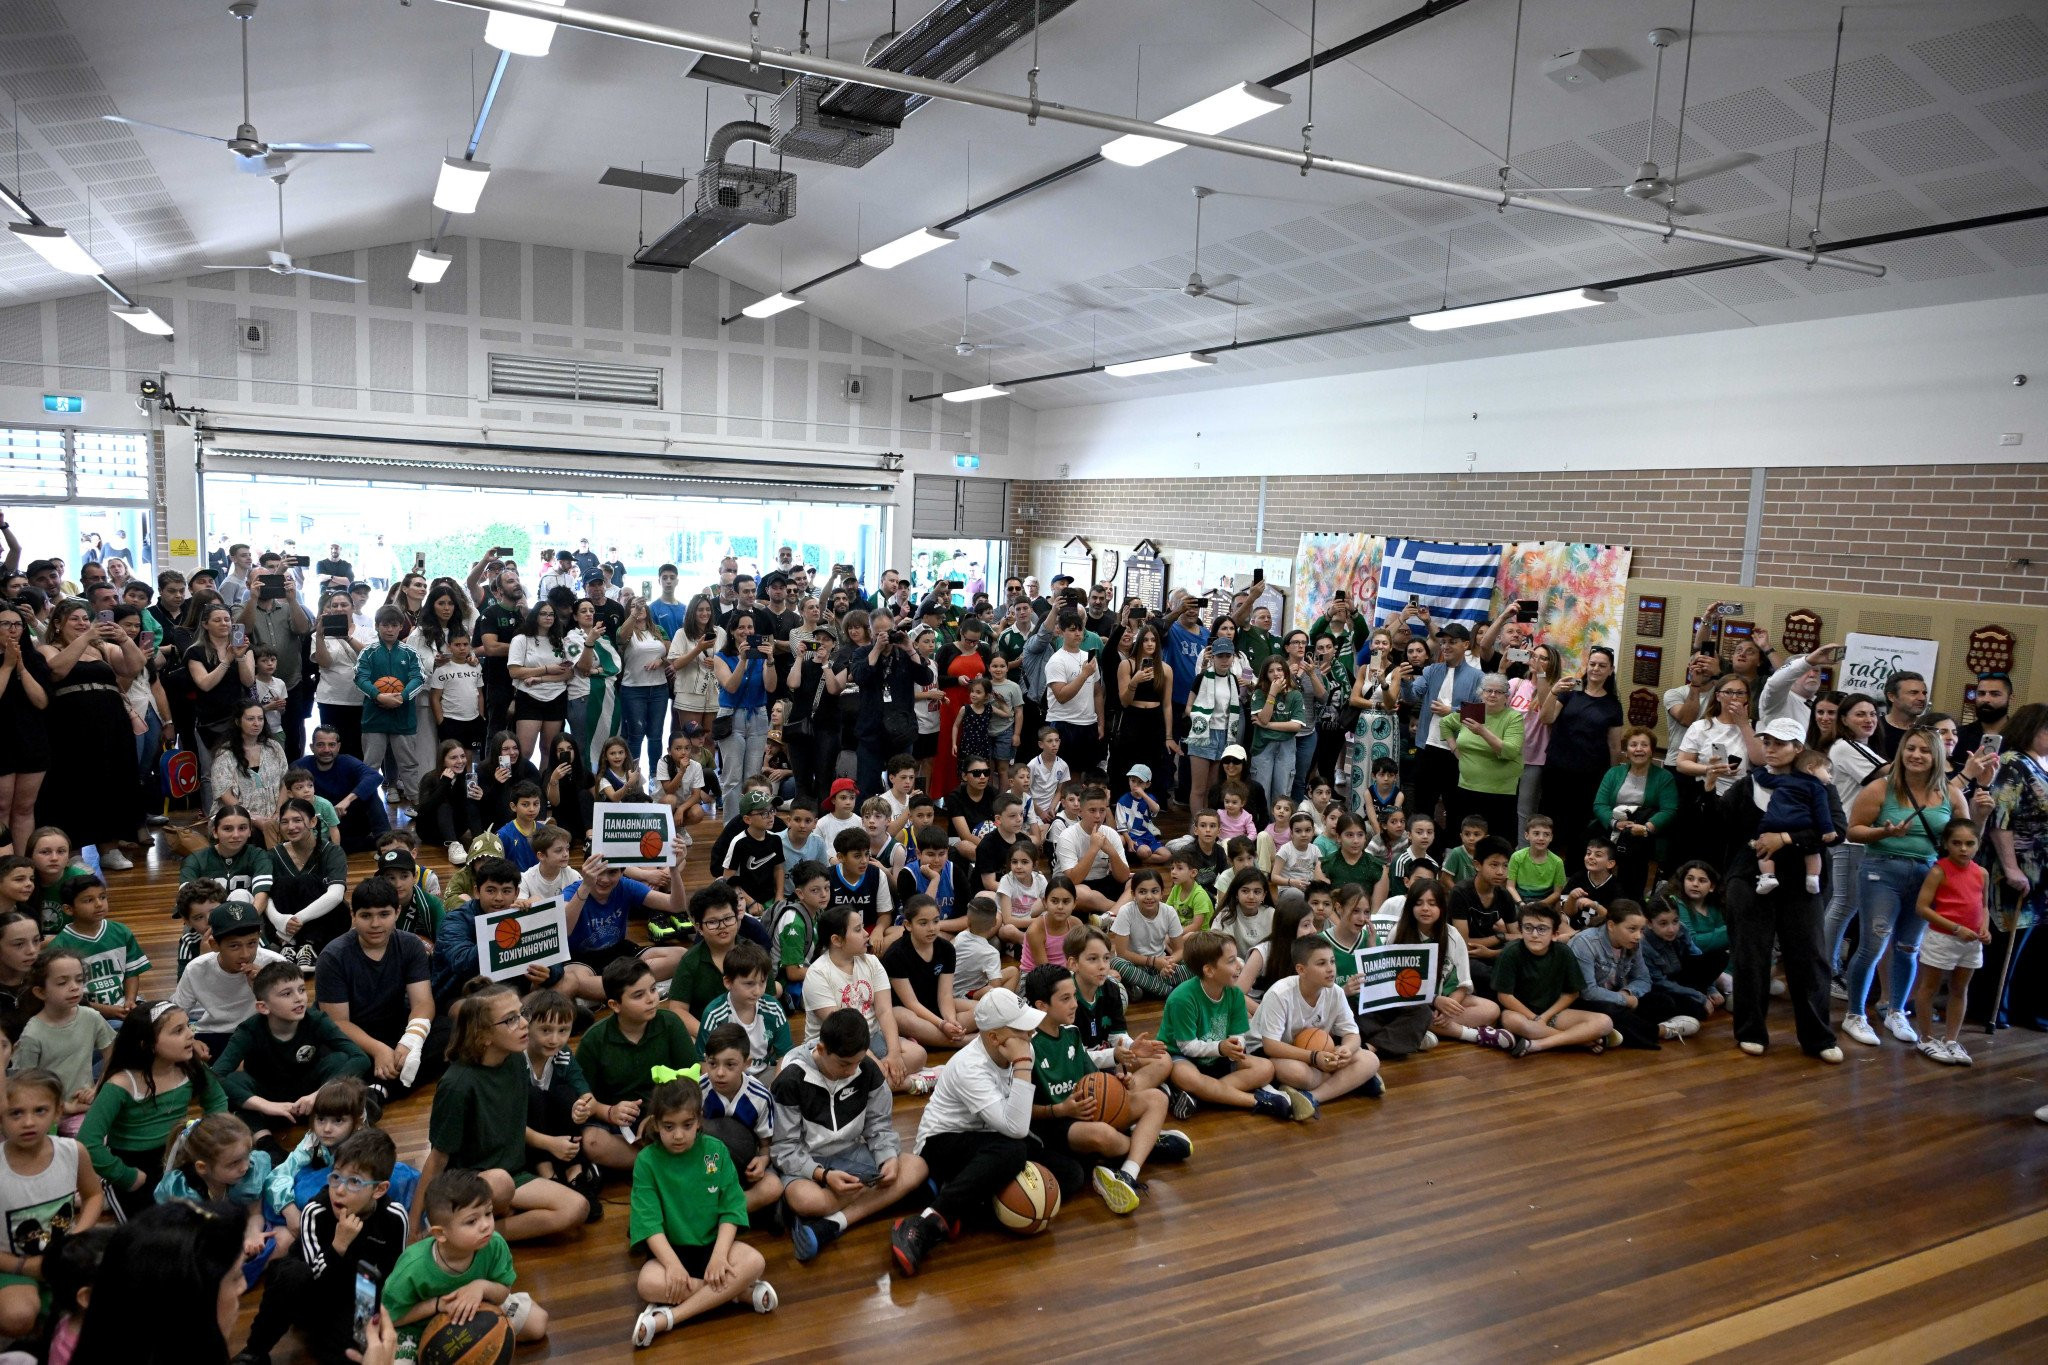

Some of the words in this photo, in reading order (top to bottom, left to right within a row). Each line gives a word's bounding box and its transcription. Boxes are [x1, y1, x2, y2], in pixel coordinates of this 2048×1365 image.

[604, 818, 662, 830] ΠΑΝΑΘΗΝΑΙΚΟΣ
[834, 895, 871, 904] ΕΛΛΑΣ
[498, 936, 559, 963] ΠΑΝΑΘΗΝΑΙΚΟΣ
[1363, 956, 1421, 973] ΠΑΝΑΘΗΝΑΙΚΟΣ
